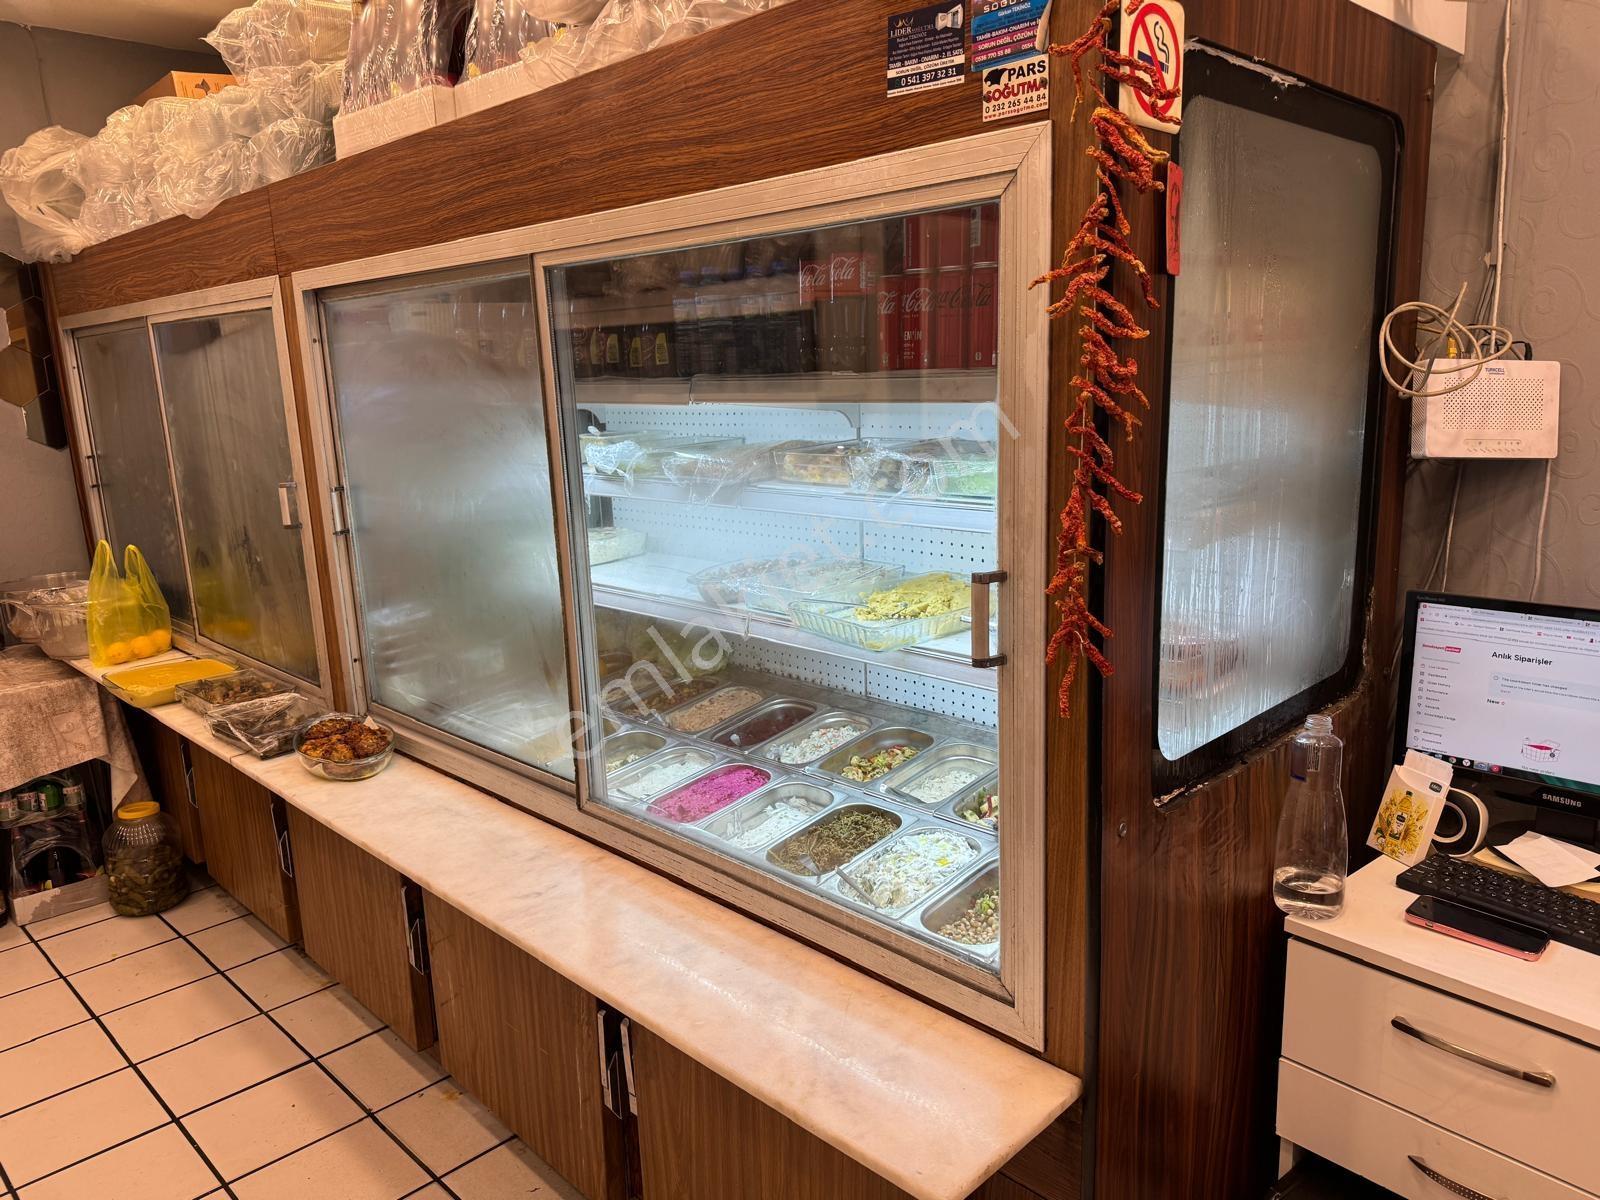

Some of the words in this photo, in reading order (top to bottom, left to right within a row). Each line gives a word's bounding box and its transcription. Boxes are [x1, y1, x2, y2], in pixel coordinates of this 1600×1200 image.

[978, 40, 996, 51] SORUN
[901, 78, 906, 86] 0
[907, 75, 920, 85] 541
[921, 71, 936, 82] 397
[936, 69, 946, 79] 32
[947, 67, 957, 76] 31
[1007, 60, 1046, 82] PARS
[992, 102, 1005, 112] 232
[1008, 99, 1021, 108] 265
[1023, 95, 1034, 104] 44
[1036, 93, 1046, 102] 84
[1492, 651, 1512, 660] Anlık
[1514, 654, 1553, 666] Siparişler
[1542, 793, 1582, 807] SAMSUNG
